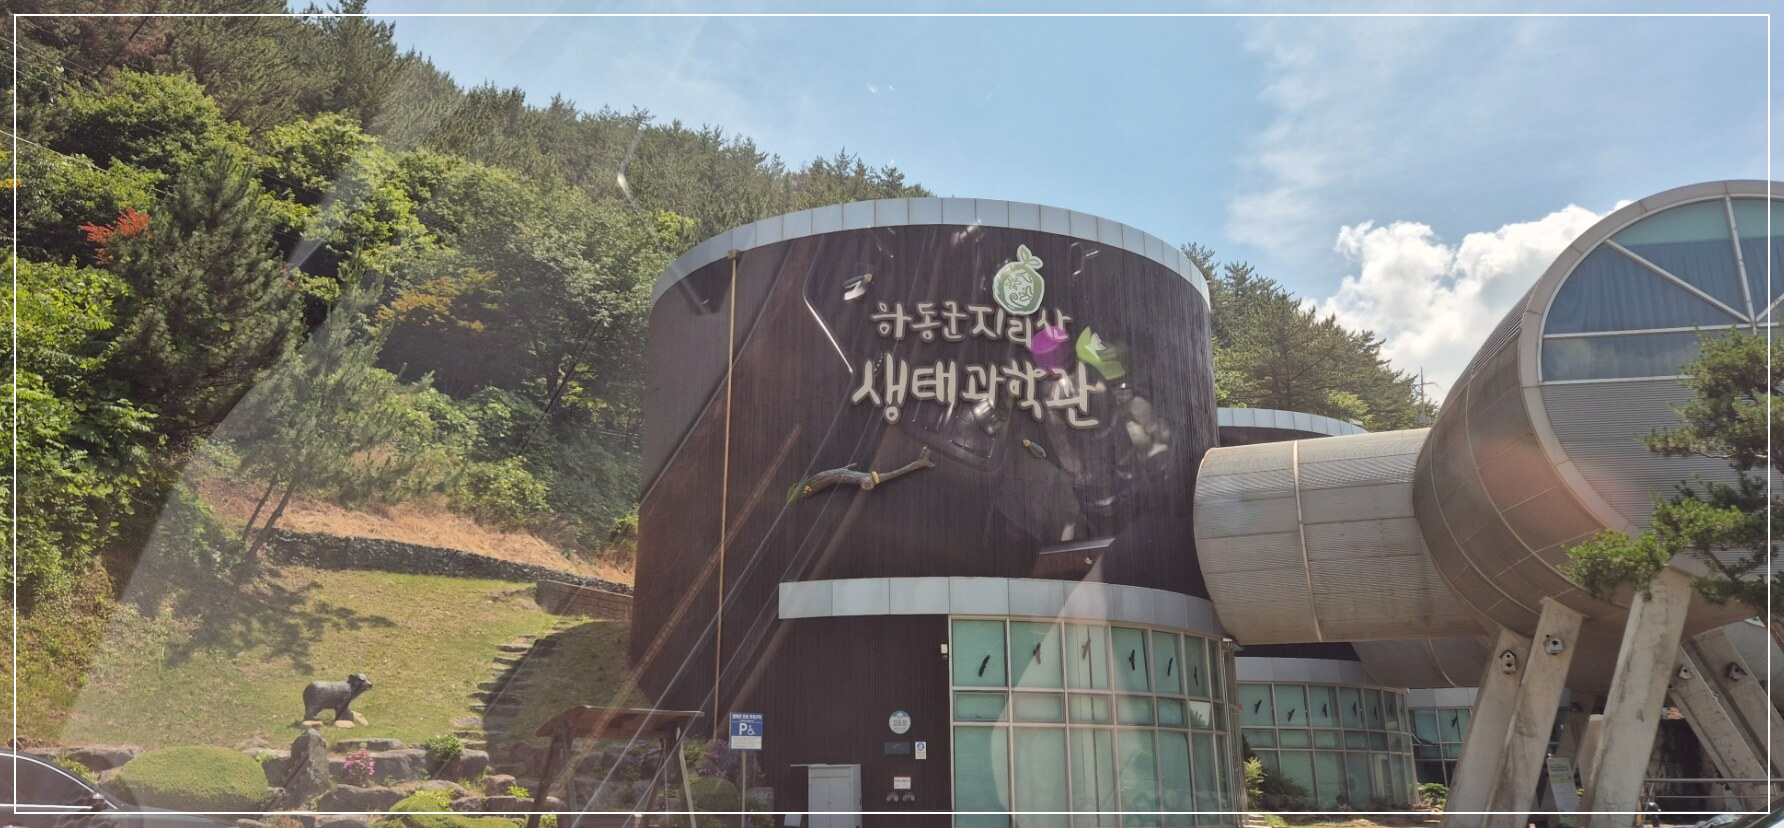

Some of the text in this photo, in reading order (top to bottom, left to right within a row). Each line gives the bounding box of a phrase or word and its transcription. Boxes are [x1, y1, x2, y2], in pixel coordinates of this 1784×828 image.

[872, 302, 1072, 348] 하동군지리산
[852, 353, 1102, 427] 생태과학관
[739, 723, 748, 736] P
